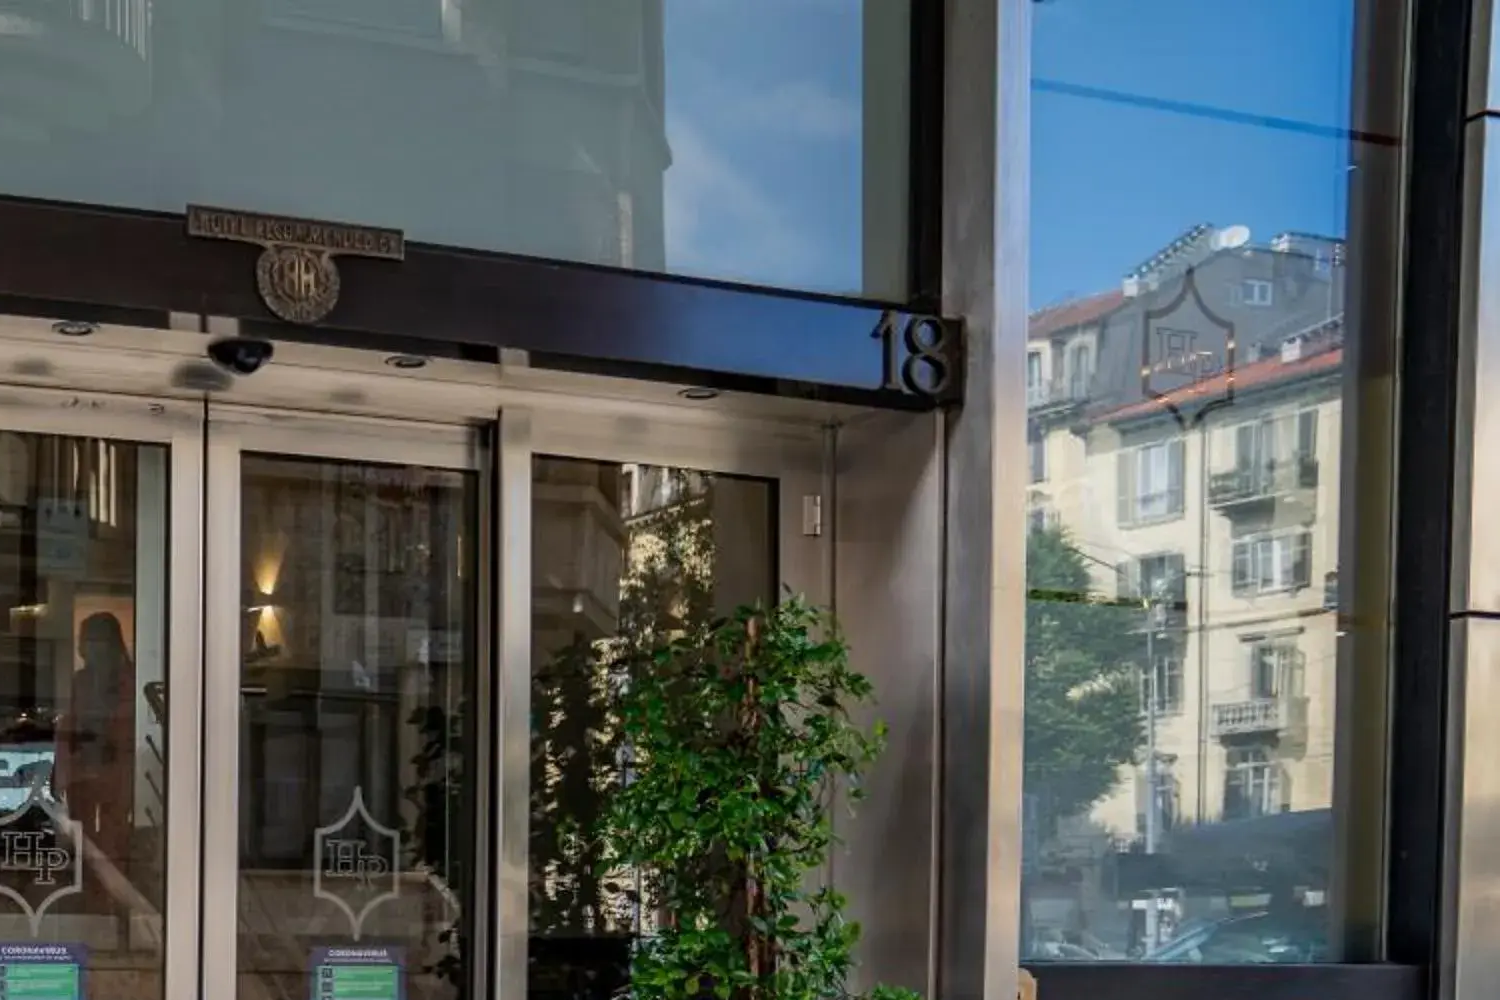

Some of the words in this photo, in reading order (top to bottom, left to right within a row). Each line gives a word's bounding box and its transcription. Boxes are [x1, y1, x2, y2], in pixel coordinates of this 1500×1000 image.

[870, 308, 948, 396] 18
[0, 831, 70, 885] HP
[325, 839, 389, 891] HP
